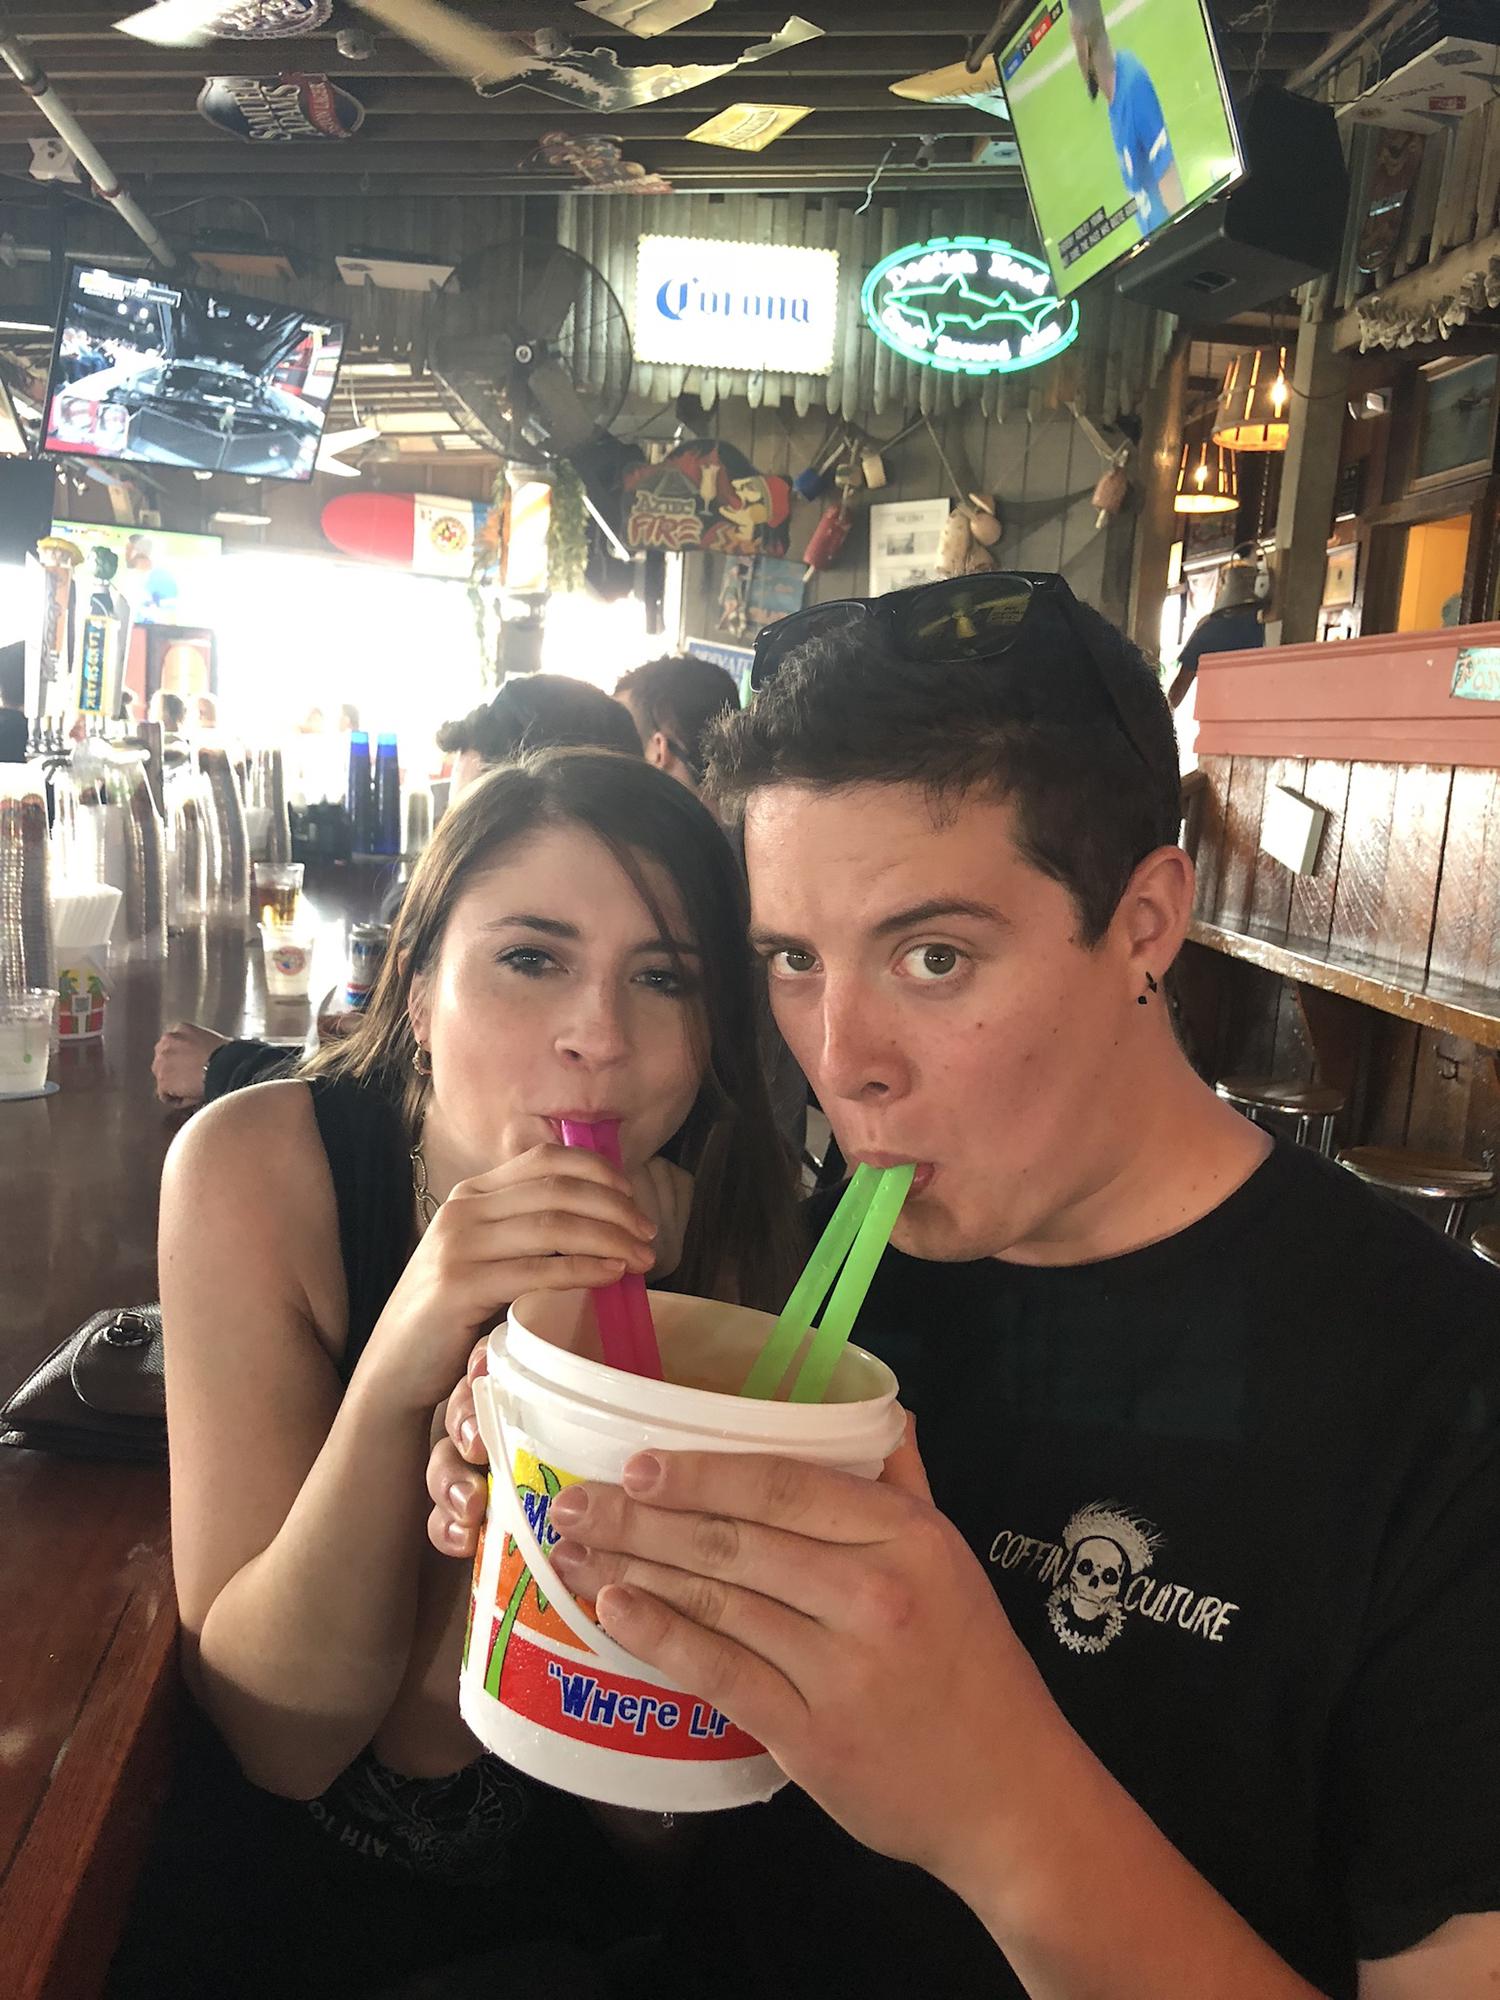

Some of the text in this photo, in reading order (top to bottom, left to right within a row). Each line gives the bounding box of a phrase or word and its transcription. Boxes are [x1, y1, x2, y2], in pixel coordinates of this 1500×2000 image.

[656, 276, 810, 324] Corona
[627, 512, 704, 551] FIRE
[988, 1530, 1074, 1587] COFFIN
[1122, 1575, 1242, 1643] CULTURE
